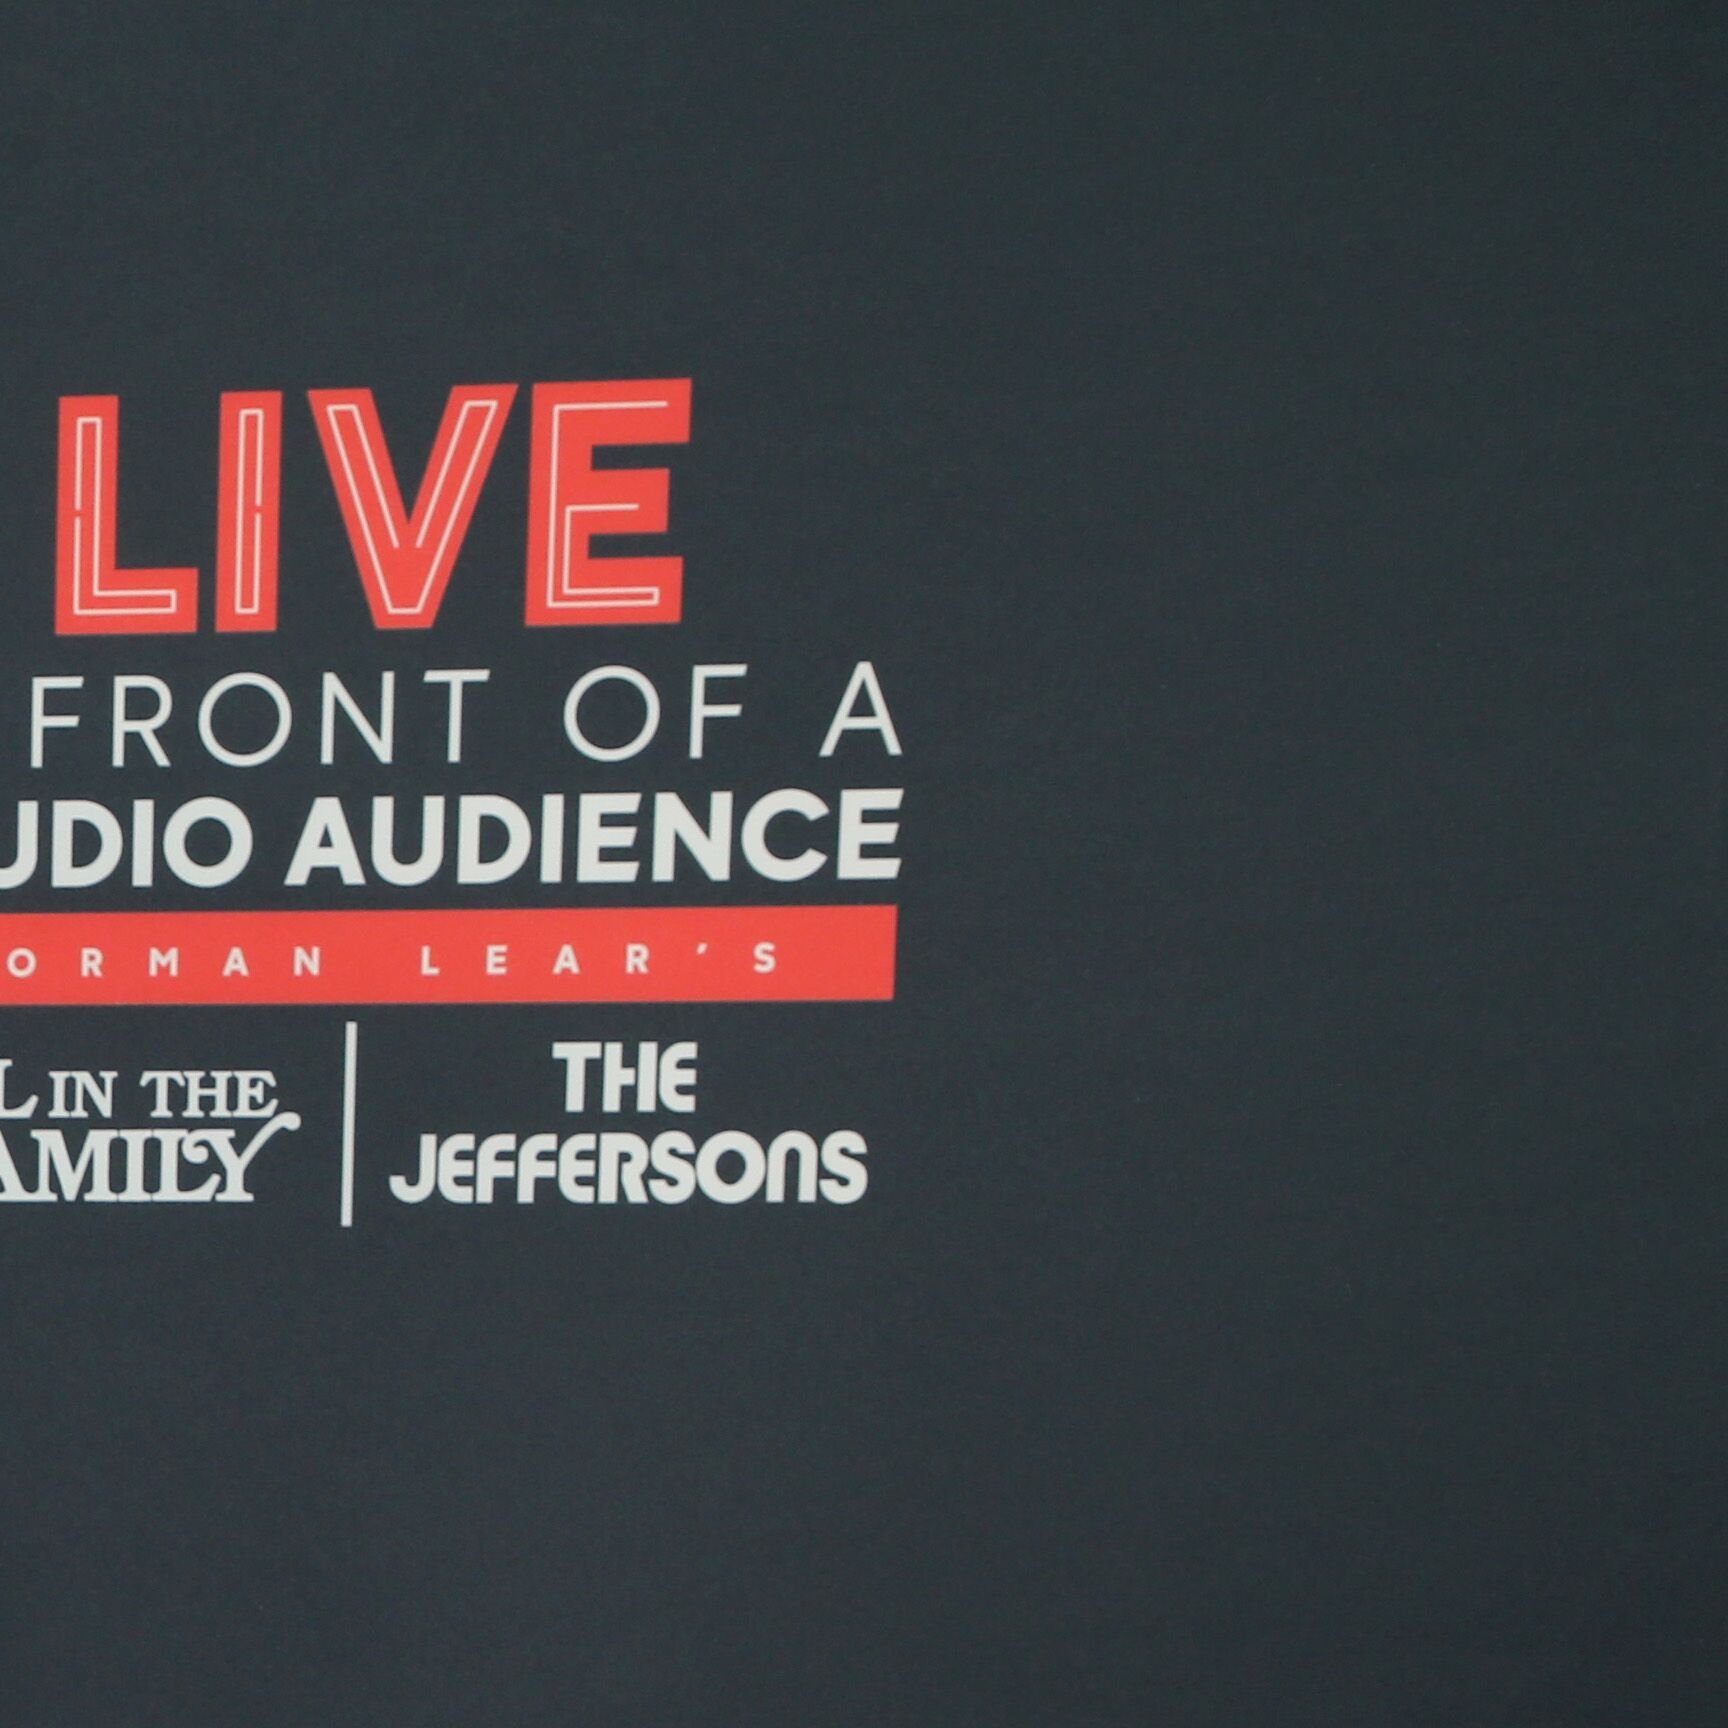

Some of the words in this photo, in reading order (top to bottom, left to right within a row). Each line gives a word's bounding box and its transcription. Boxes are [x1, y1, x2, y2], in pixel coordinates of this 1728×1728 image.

[54, 377, 693, 636] LIVE
[30, 668, 491, 769] FRONT
[563, 663, 749, 762] OF
[819, 660, 903, 757] A
[283, 787, 905, 887] AUDIENCE
[419, 941, 778, 977] LEAR'S
[47, 1069, 120, 1120] IN
[138, 1069, 280, 1119] THE
[551, 1040, 699, 1114] THE
[388, 1130, 869, 1206] JEFFERSONS
